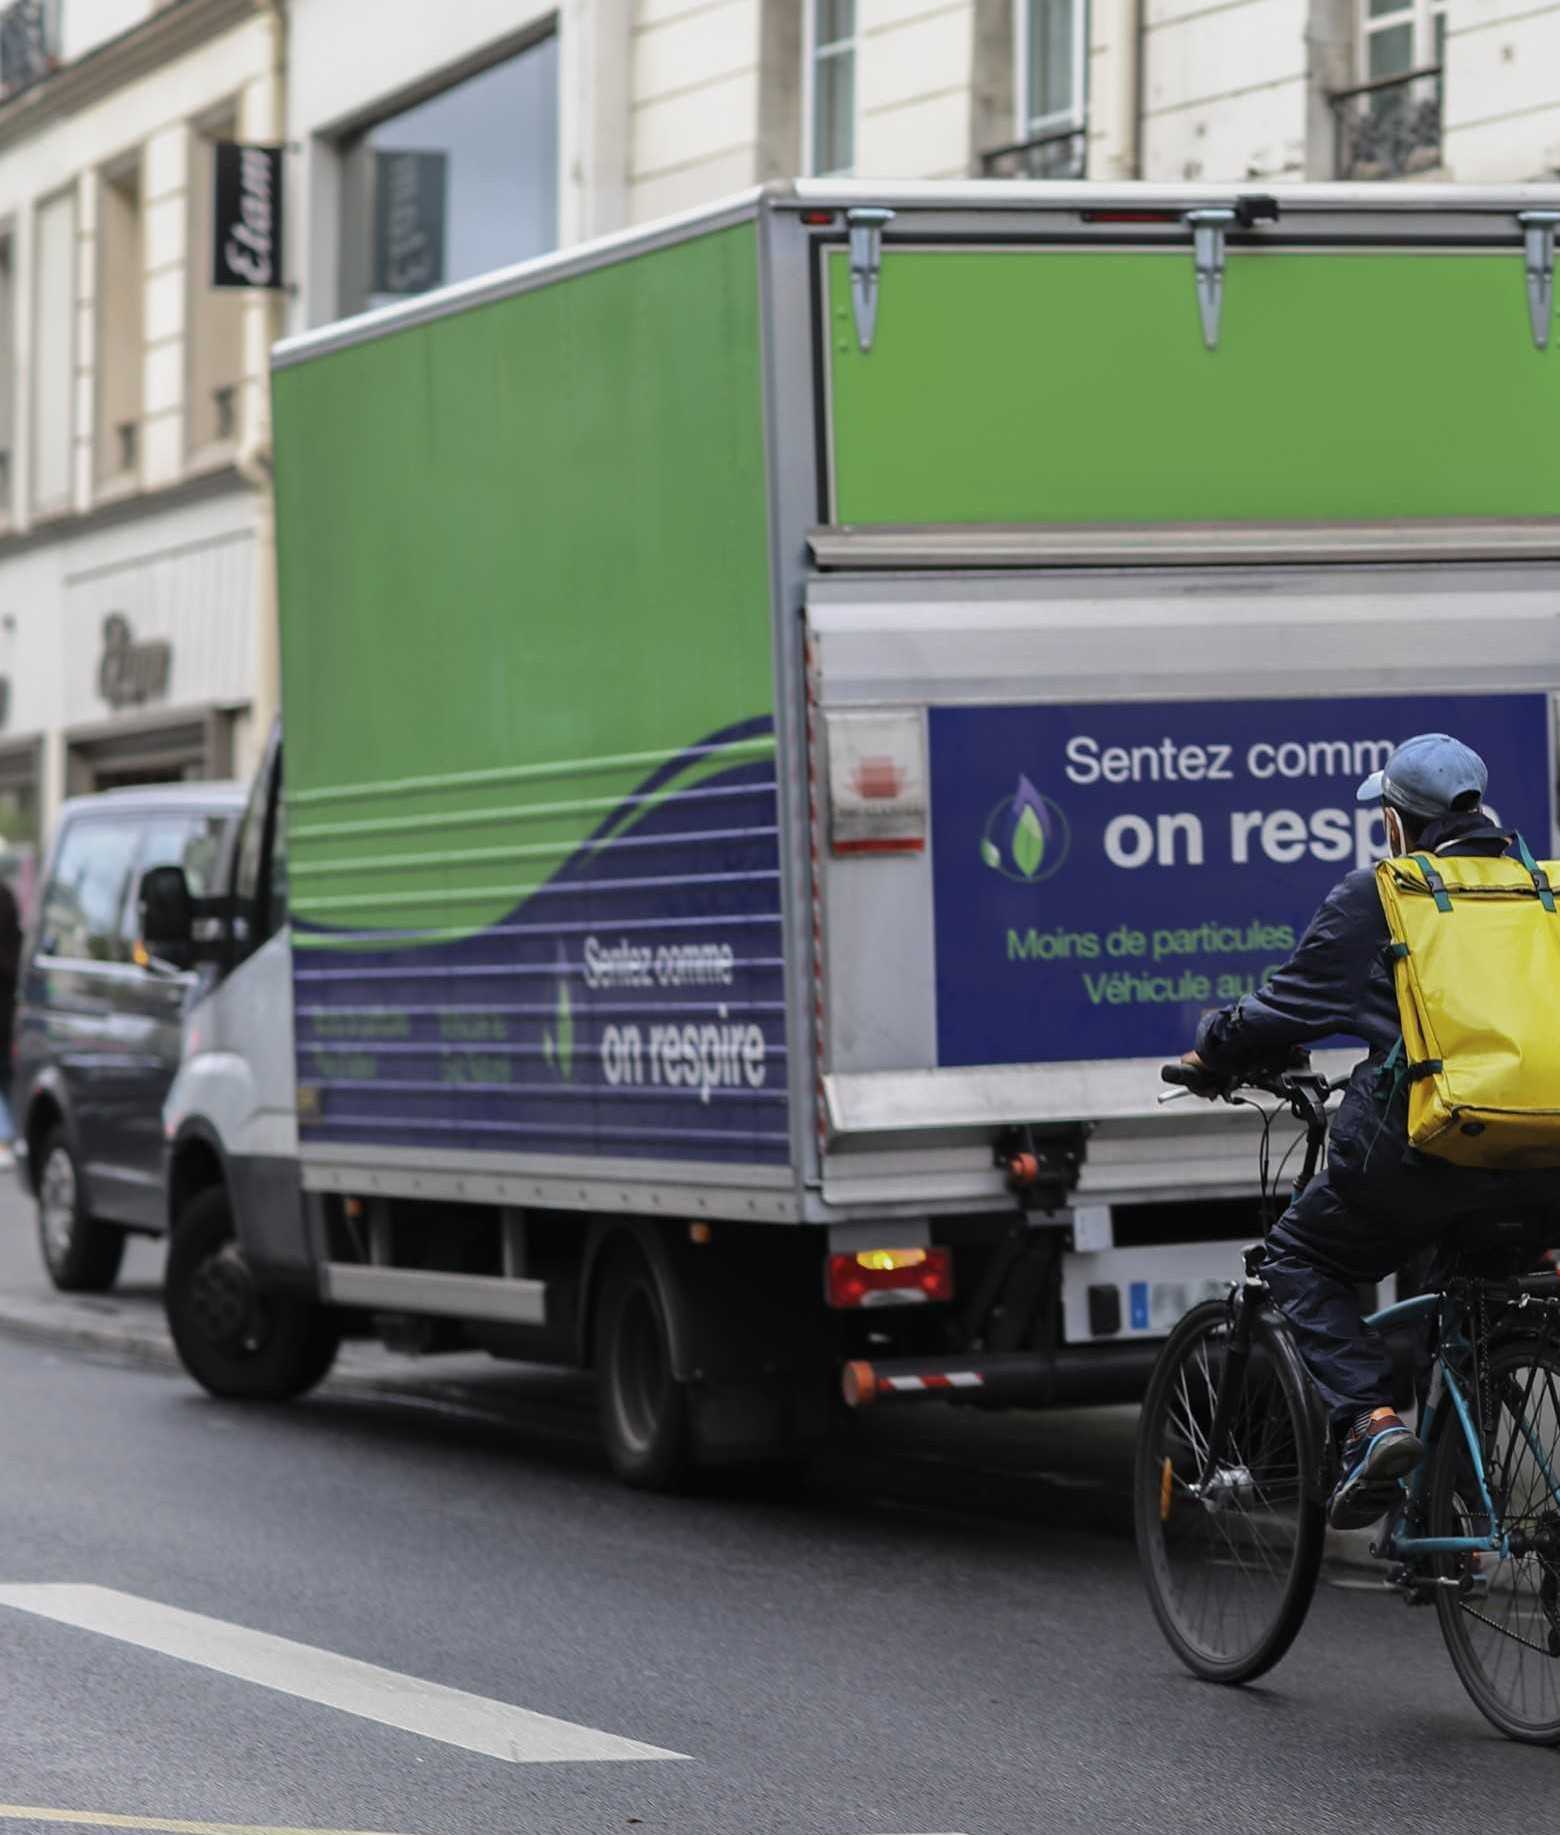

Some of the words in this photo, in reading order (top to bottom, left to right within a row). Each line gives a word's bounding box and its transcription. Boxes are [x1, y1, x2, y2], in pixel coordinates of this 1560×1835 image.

[224, 148, 273, 286] Etam
[1065, 735, 1234, 785] Sentez
[1246, 739, 1396, 779] comm
[1104, 813, 1204, 869] on
[1230, 807, 1391, 869] resp
[584, 936, 653, 988] Sentez
[656, 943, 734, 987] comme
[1006, 927, 1099, 961] Moins
[1106, 924, 1146, 957] de
[1152, 918, 1295, 963] particules
[1082, 968, 1212, 1005] Véhicule
[1217, 972, 1255, 999] au
[601, 1023, 644, 1088] on
[651, 1003, 766, 1104] respire
